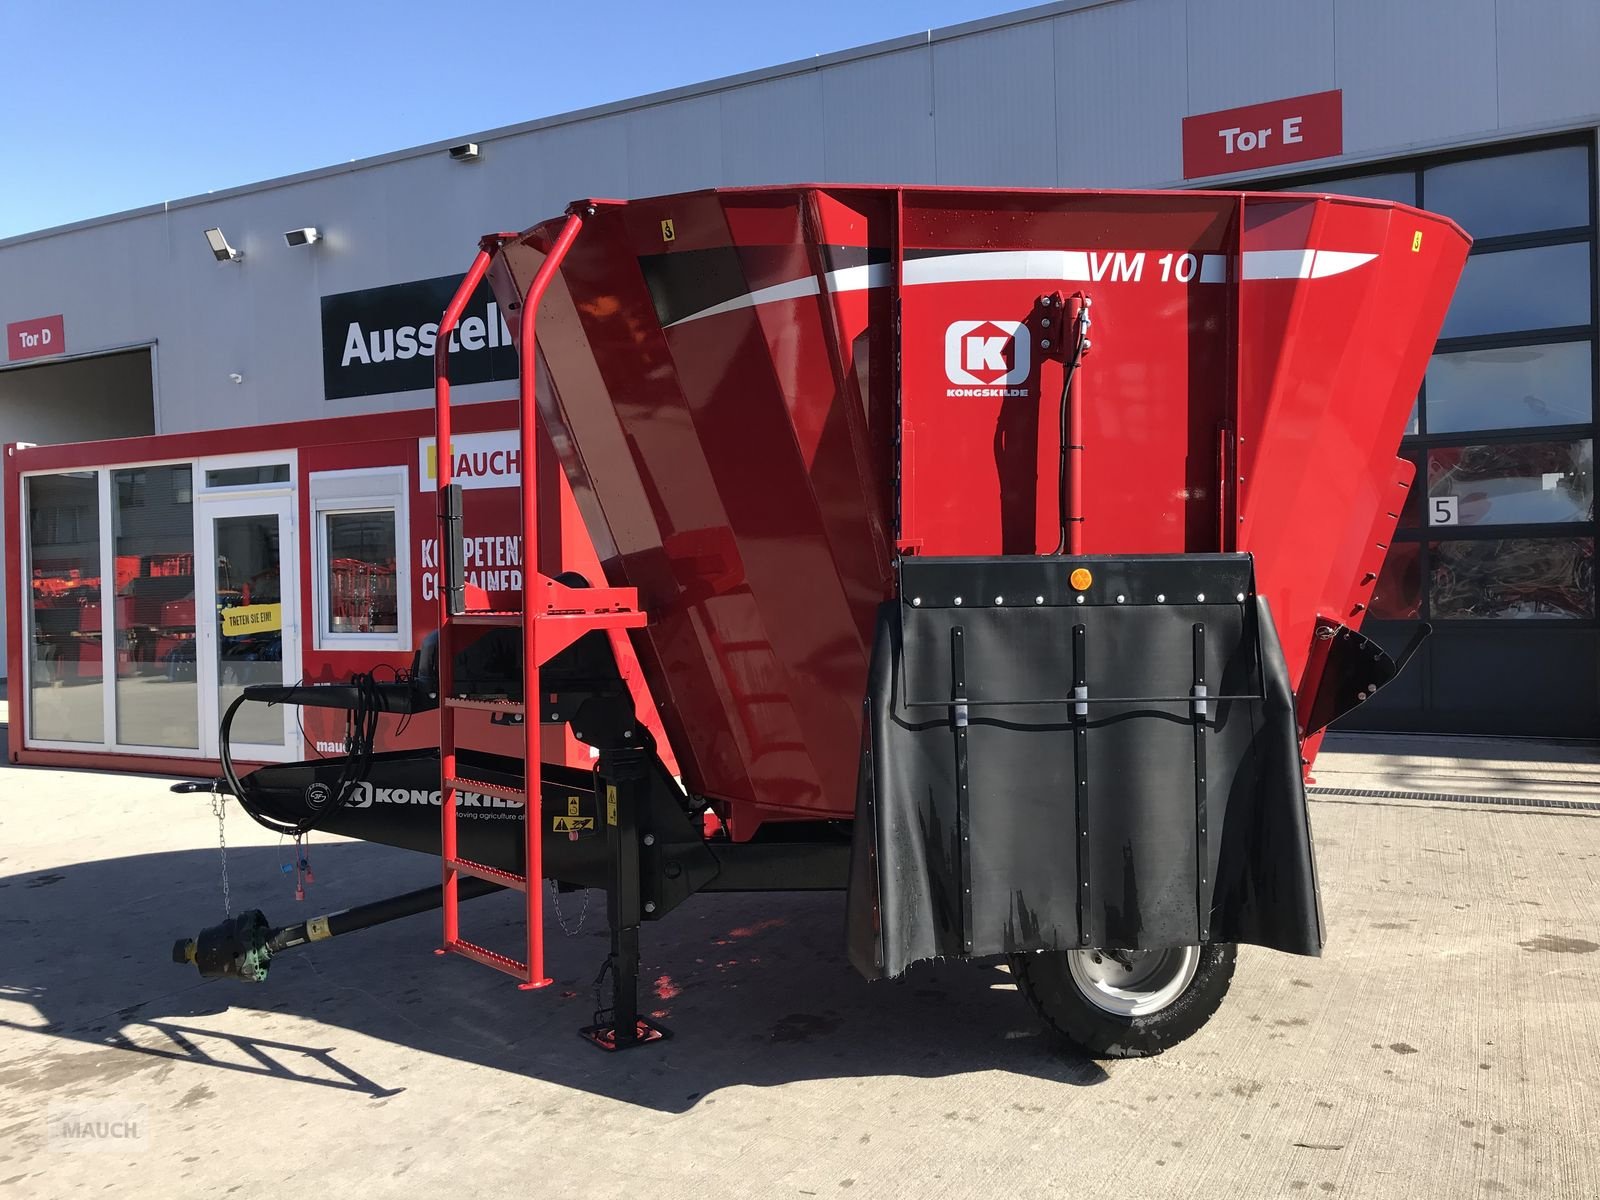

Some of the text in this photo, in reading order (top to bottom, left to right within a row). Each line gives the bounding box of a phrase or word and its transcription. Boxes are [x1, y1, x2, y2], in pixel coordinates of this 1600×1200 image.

[1219, 117, 1303, 153] Tor E
[1090, 252, 1197, 282] VM 10
[19, 328, 51, 348] Tor D
[947, 389, 1029, 397] KONGSKILDE
[1435, 500, 1451, 523] 5
[229, 615, 250, 626] TRETEN
[250, 613, 260, 623] SIE
